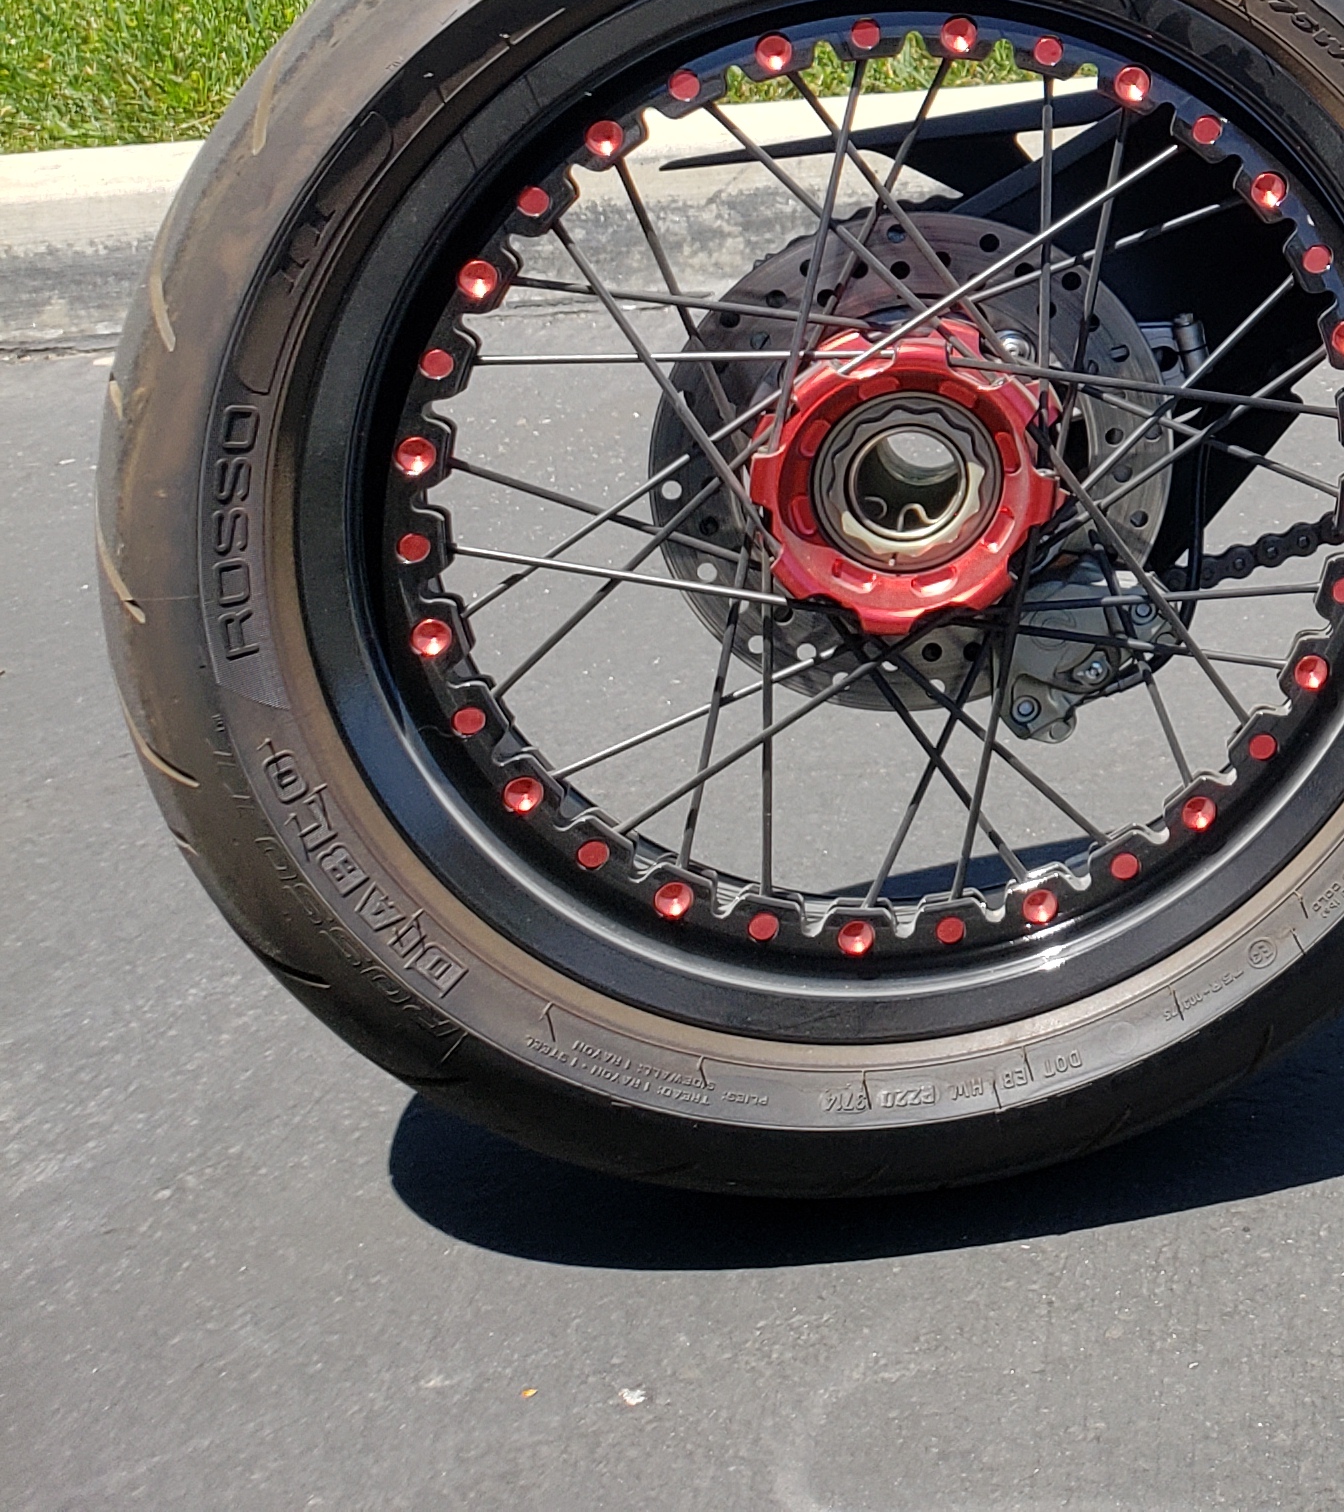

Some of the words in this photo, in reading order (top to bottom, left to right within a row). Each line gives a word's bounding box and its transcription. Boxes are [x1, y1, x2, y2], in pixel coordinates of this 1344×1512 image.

[211, 404, 261, 662] ROSSO
[256, 743, 471, 1003] DIABLO
[1038, 1047, 1084, 1080] DOT
